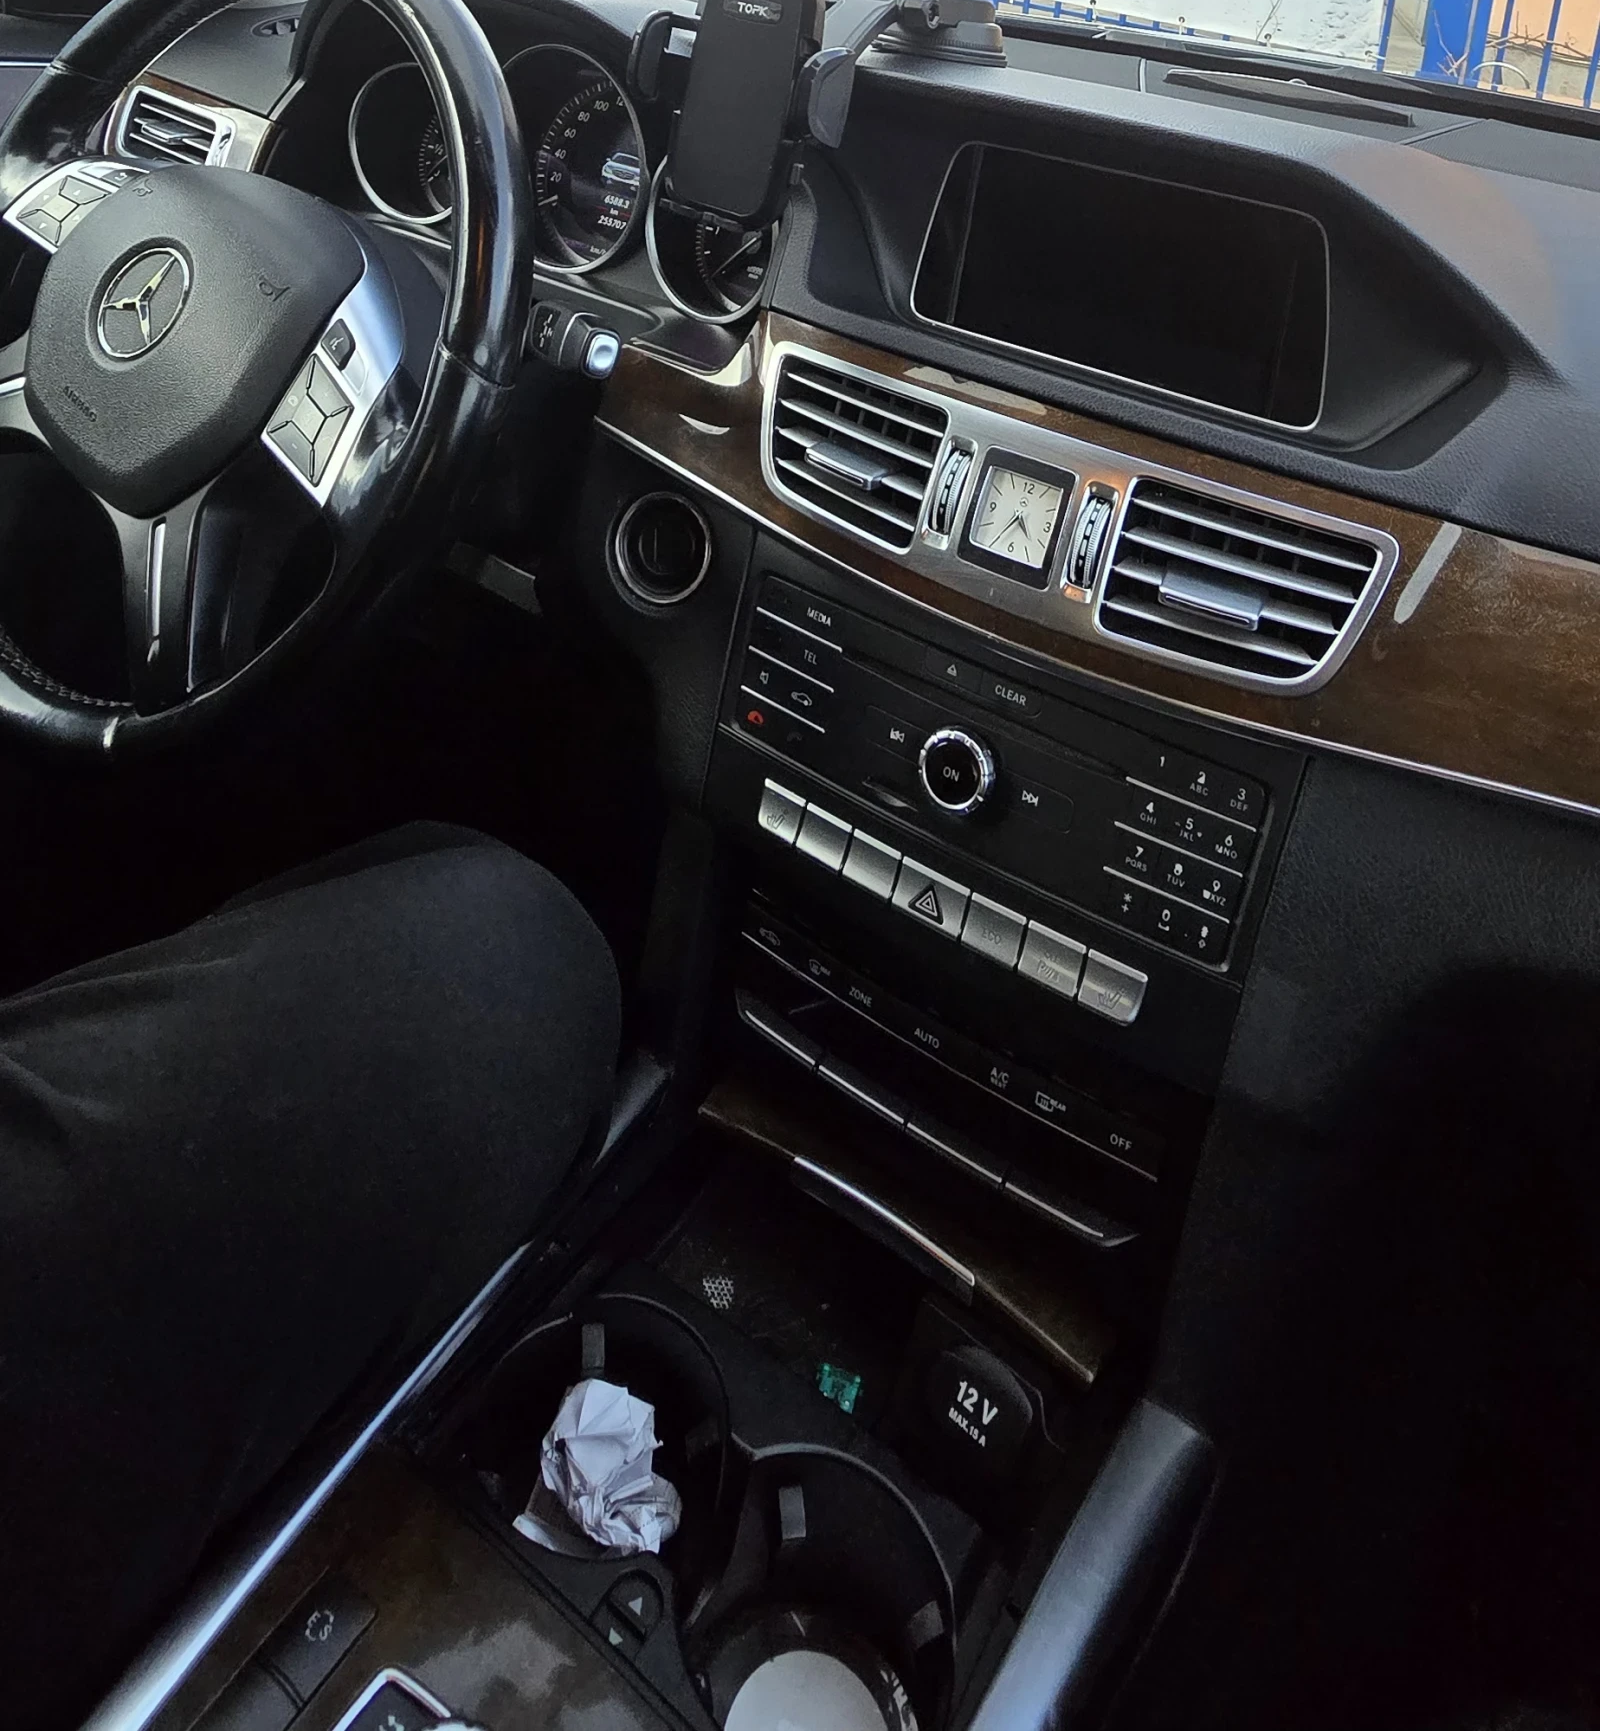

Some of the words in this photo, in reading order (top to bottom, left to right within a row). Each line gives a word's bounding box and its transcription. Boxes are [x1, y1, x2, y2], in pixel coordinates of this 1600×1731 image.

[737, 1, 769, 19] TOPK
[593, 100, 609, 112] 100
[577, 112, 590, 122] 80
[564, 128, 576, 139] 60
[554, 149, 566, 159] 40
[550, 172, 562, 182] 20
[597, 215, 627, 230] 255707
[1023, 482, 1035, 495] 12
[990, 502, 997, 513] 9
[1043, 522, 1052, 533] 3
[1007, 542, 1014, 553] 6
[806, 607, 831, 627] MEDIA
[803, 649, 817, 665] TEL
[995, 684, 1027, 706] CLEAR
[1160, 756, 1165, 767] 1
[943, 766, 960, 782] ON
[1197, 771, 1206, 784] 2
[1189, 782, 1209, 796] ABC
[1237, 788, 1246, 800] 3
[1146, 802, 1154, 813] 4
[1230, 799, 1248, 812] DEF
[1140, 812, 1157, 825] GHI
[1185, 818, 1194, 830] 5
[1180, 829, 1194, 842] JKL
[1224, 835, 1233, 847] 6
[1135, 845, 1144, 858] 7
[1125, 856, 1148, 872] PQRS
[1173, 863, 1183, 876] 8
[1166, 874, 1185, 887] TUV
[1212, 880, 1221, 892] 9
[1162, 909, 1171, 922] 0
[982, 930, 1001, 945] ECO
[849, 986, 873, 1008] ZONE
[914, 1027, 940, 1049] AUTO
[990, 1067, 1010, 1084] A/C
[1109, 1133, 1132, 1151] OFF
[957, 1380, 979, 1414] 12
[982, 1398, 998, 1425] V
[969, 1425, 979, 1440] 15
[978, 1434, 986, 1447] A
